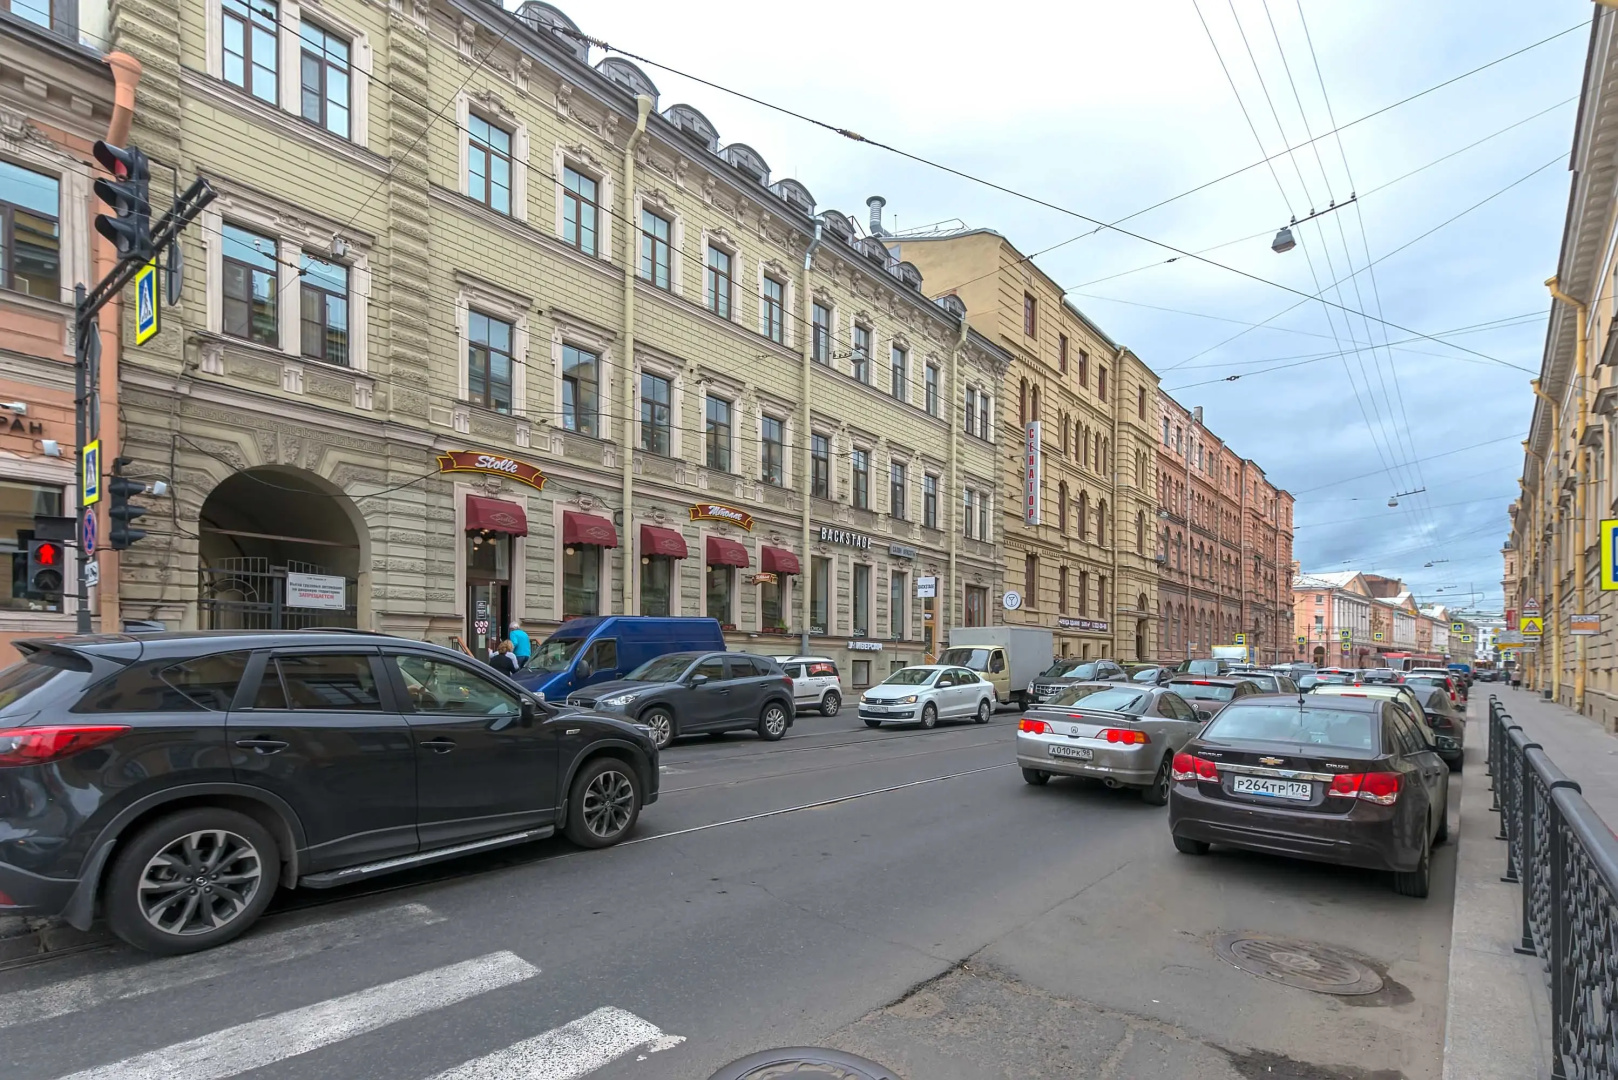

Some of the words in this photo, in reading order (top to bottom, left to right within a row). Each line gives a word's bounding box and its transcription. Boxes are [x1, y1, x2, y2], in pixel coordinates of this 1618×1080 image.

[475, 455, 518, 473] Stolle
[708, 505, 743, 520] Штолле
[821, 527, 871, 549] BACKSTAGE
[1237, 779, 1286, 793] Р264ТР
[1288, 783, 1308, 793] 178
